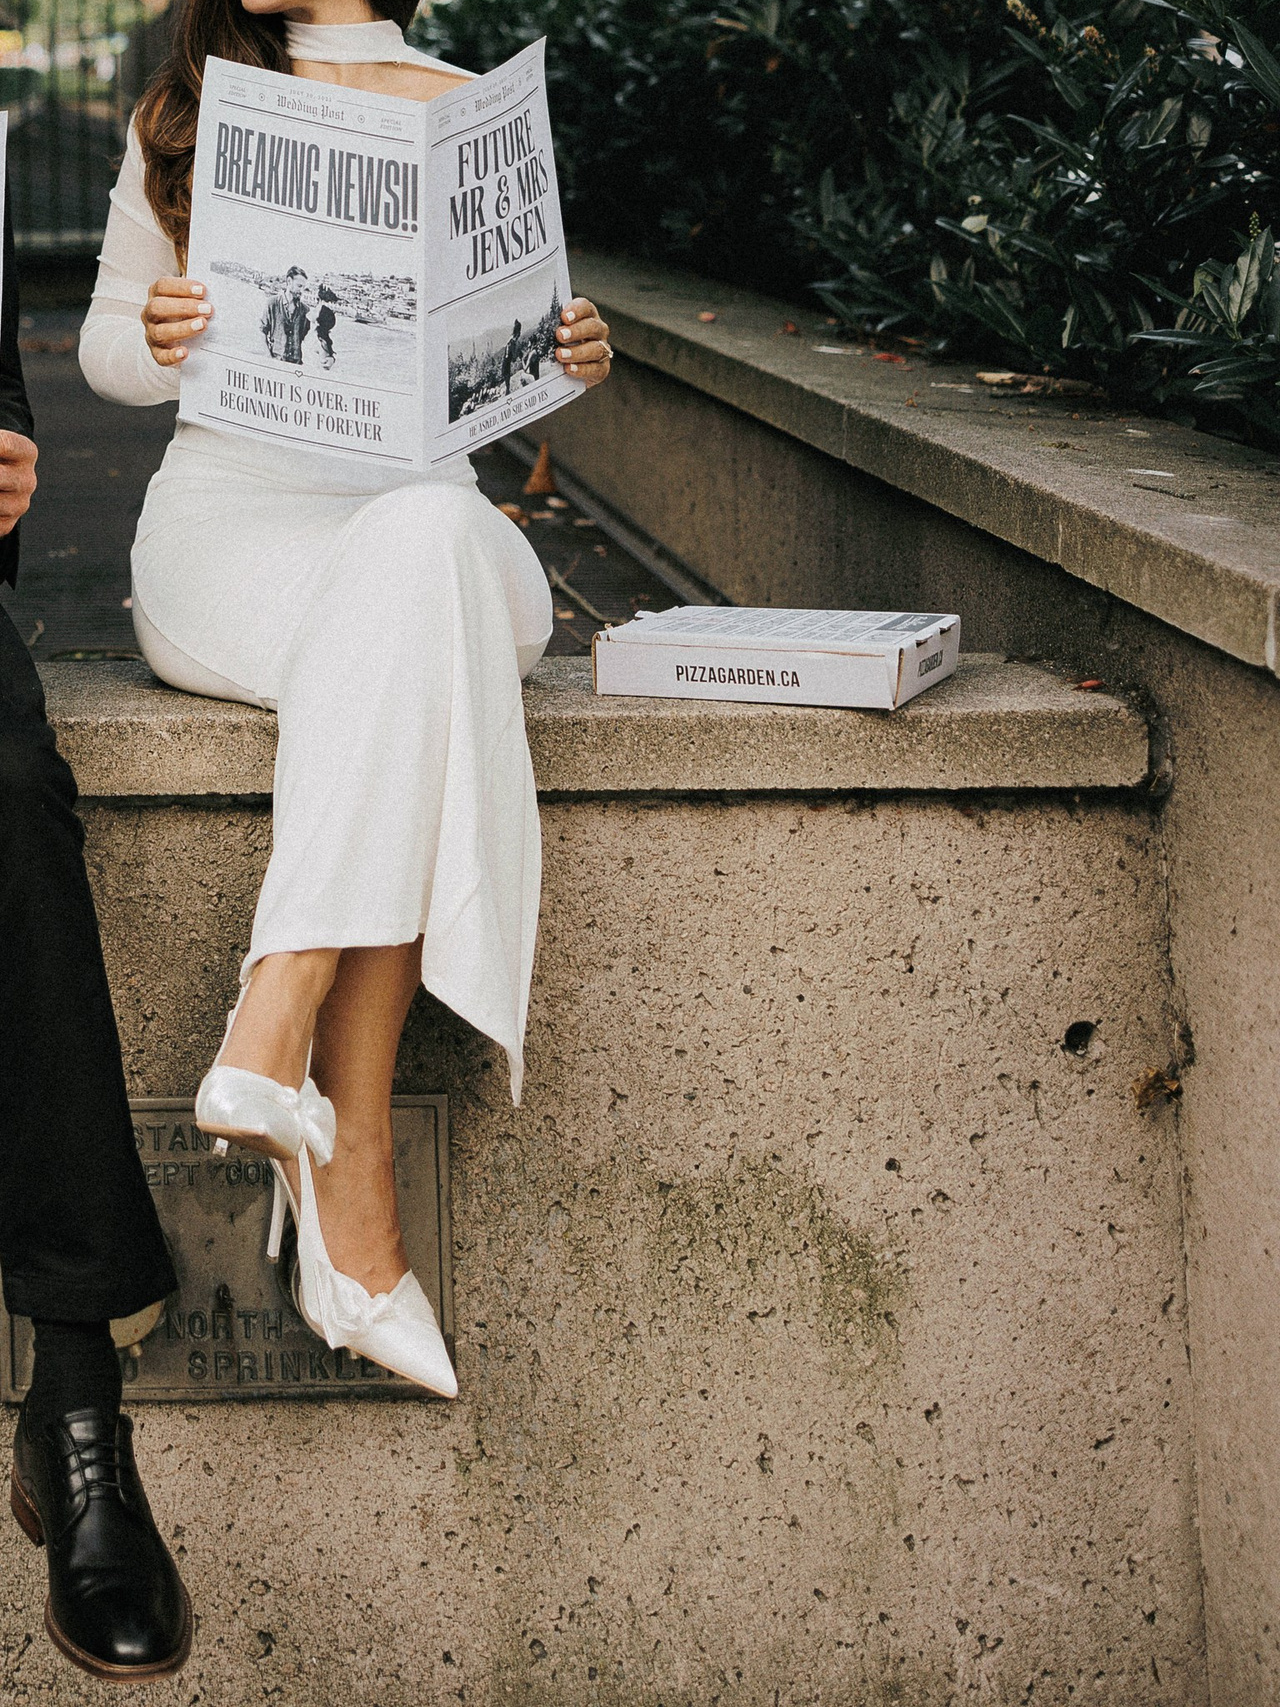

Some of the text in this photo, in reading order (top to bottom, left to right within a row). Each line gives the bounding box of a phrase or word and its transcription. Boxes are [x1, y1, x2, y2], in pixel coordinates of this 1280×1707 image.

[277, 94, 345, 121] Wedding Post
[457, 108, 536, 189] FUTURE
[214, 121, 418, 233] BREAKING NEWS!!
[449, 148, 549, 240] MR & MRS
[466, 201, 547, 281] JENSEN
[220, 389, 383, 442] BEGINNING OF FOREVER
[225, 368, 381, 419] THE WAIT IS OVER: THE
[469, 425, 477, 437] HE
[500, 408, 512, 422] AND
[512, 402, 524, 416] SHE
[524, 395, 537, 409] SAID
[675, 664, 801, 688] PIZZAGARDEN.CA
[143, 1161, 201, 1186] EPT
[166, 1309, 283, 1340] NORTH
[188, 1349, 397, 1381] SPRINKLE
